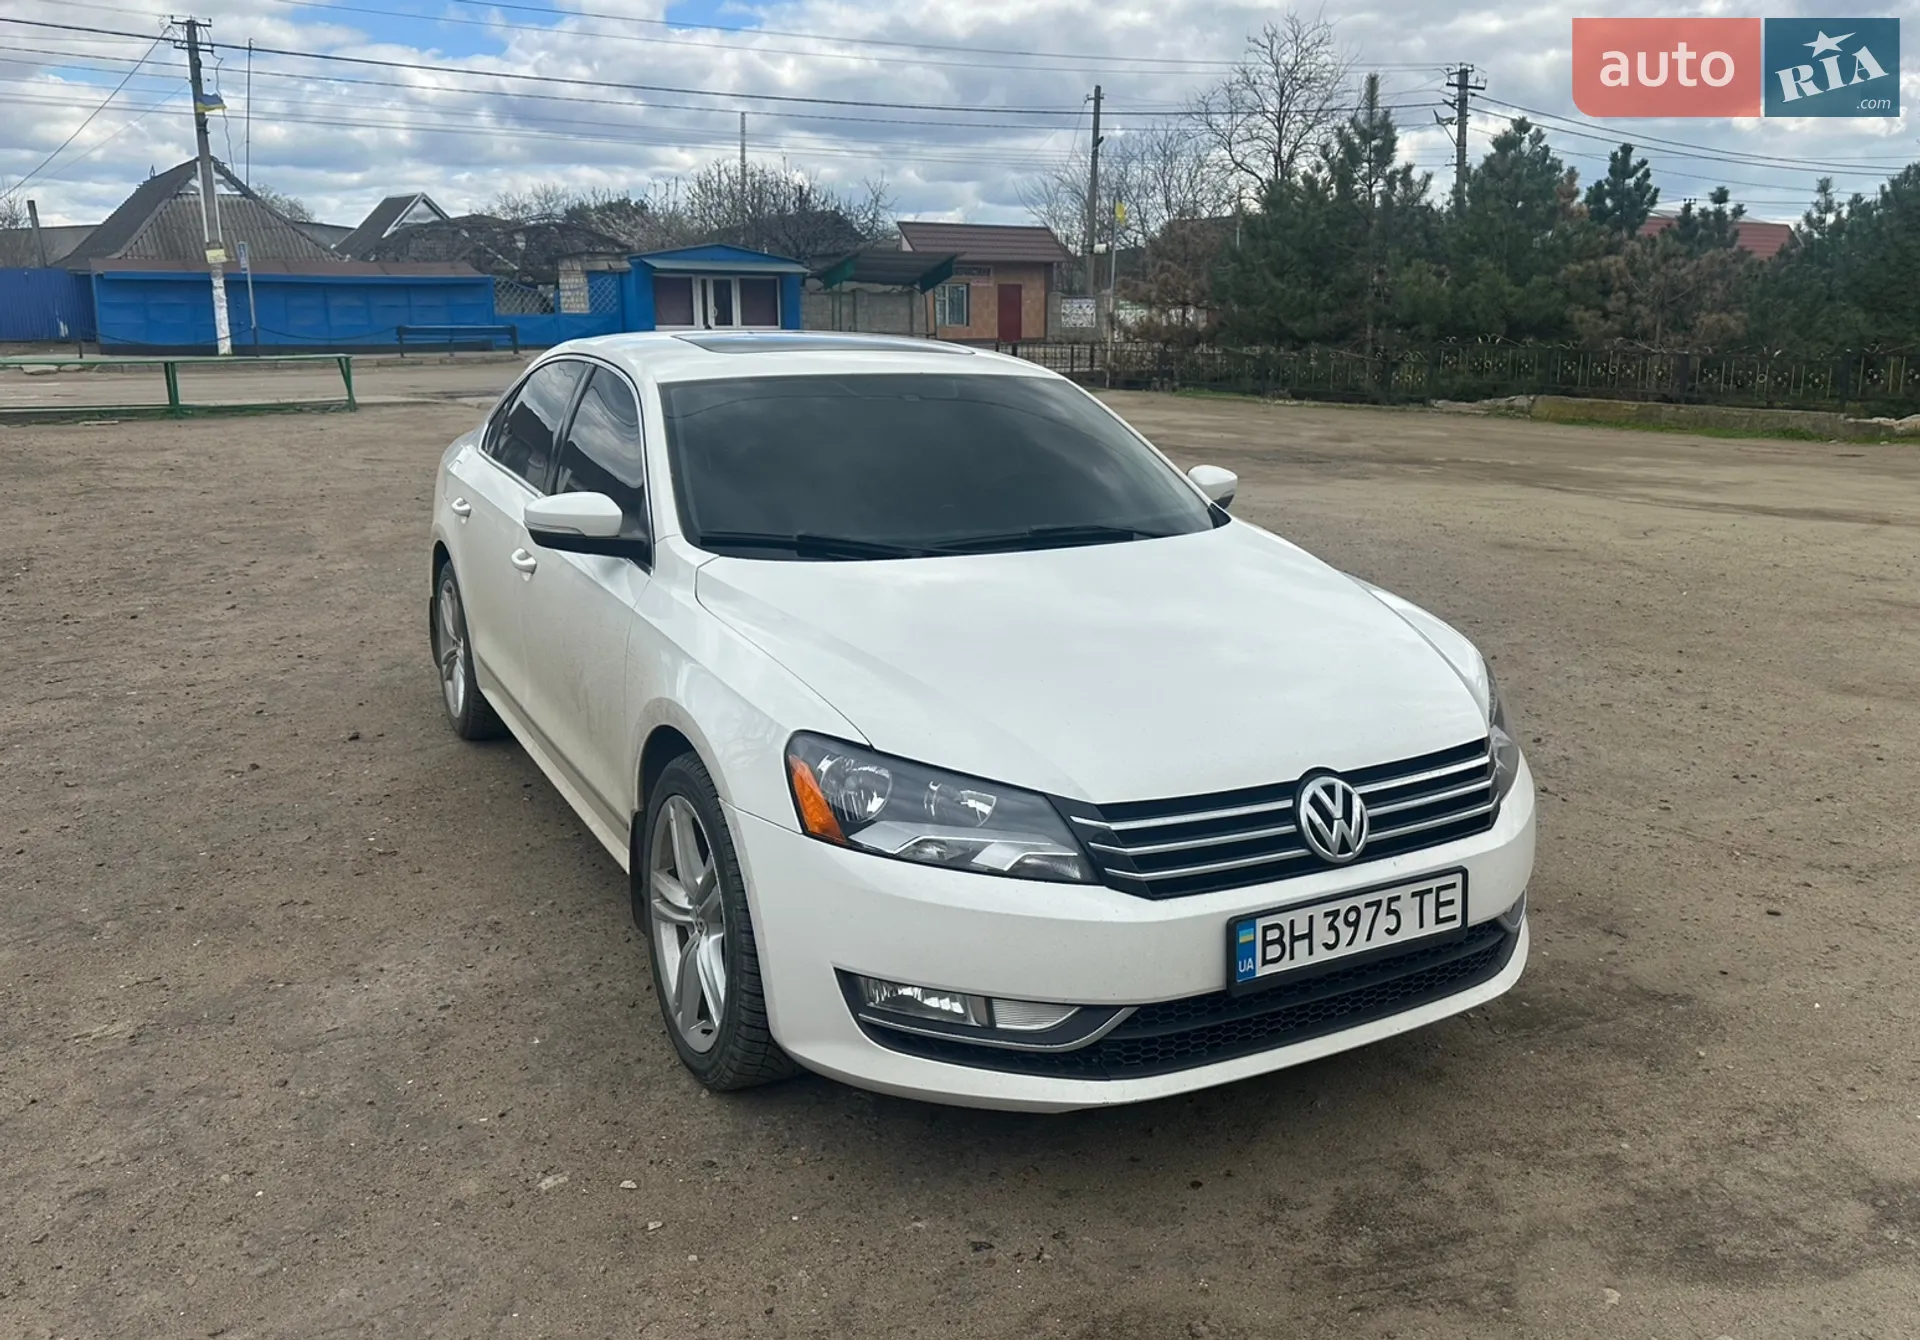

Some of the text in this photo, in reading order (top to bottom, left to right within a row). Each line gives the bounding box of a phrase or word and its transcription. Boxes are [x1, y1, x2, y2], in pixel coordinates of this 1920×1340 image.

[1301, 777, 1368, 862] VW
[1238, 958, 1255, 973] UA
[1260, 882, 1457, 967] BH 3975 TE
